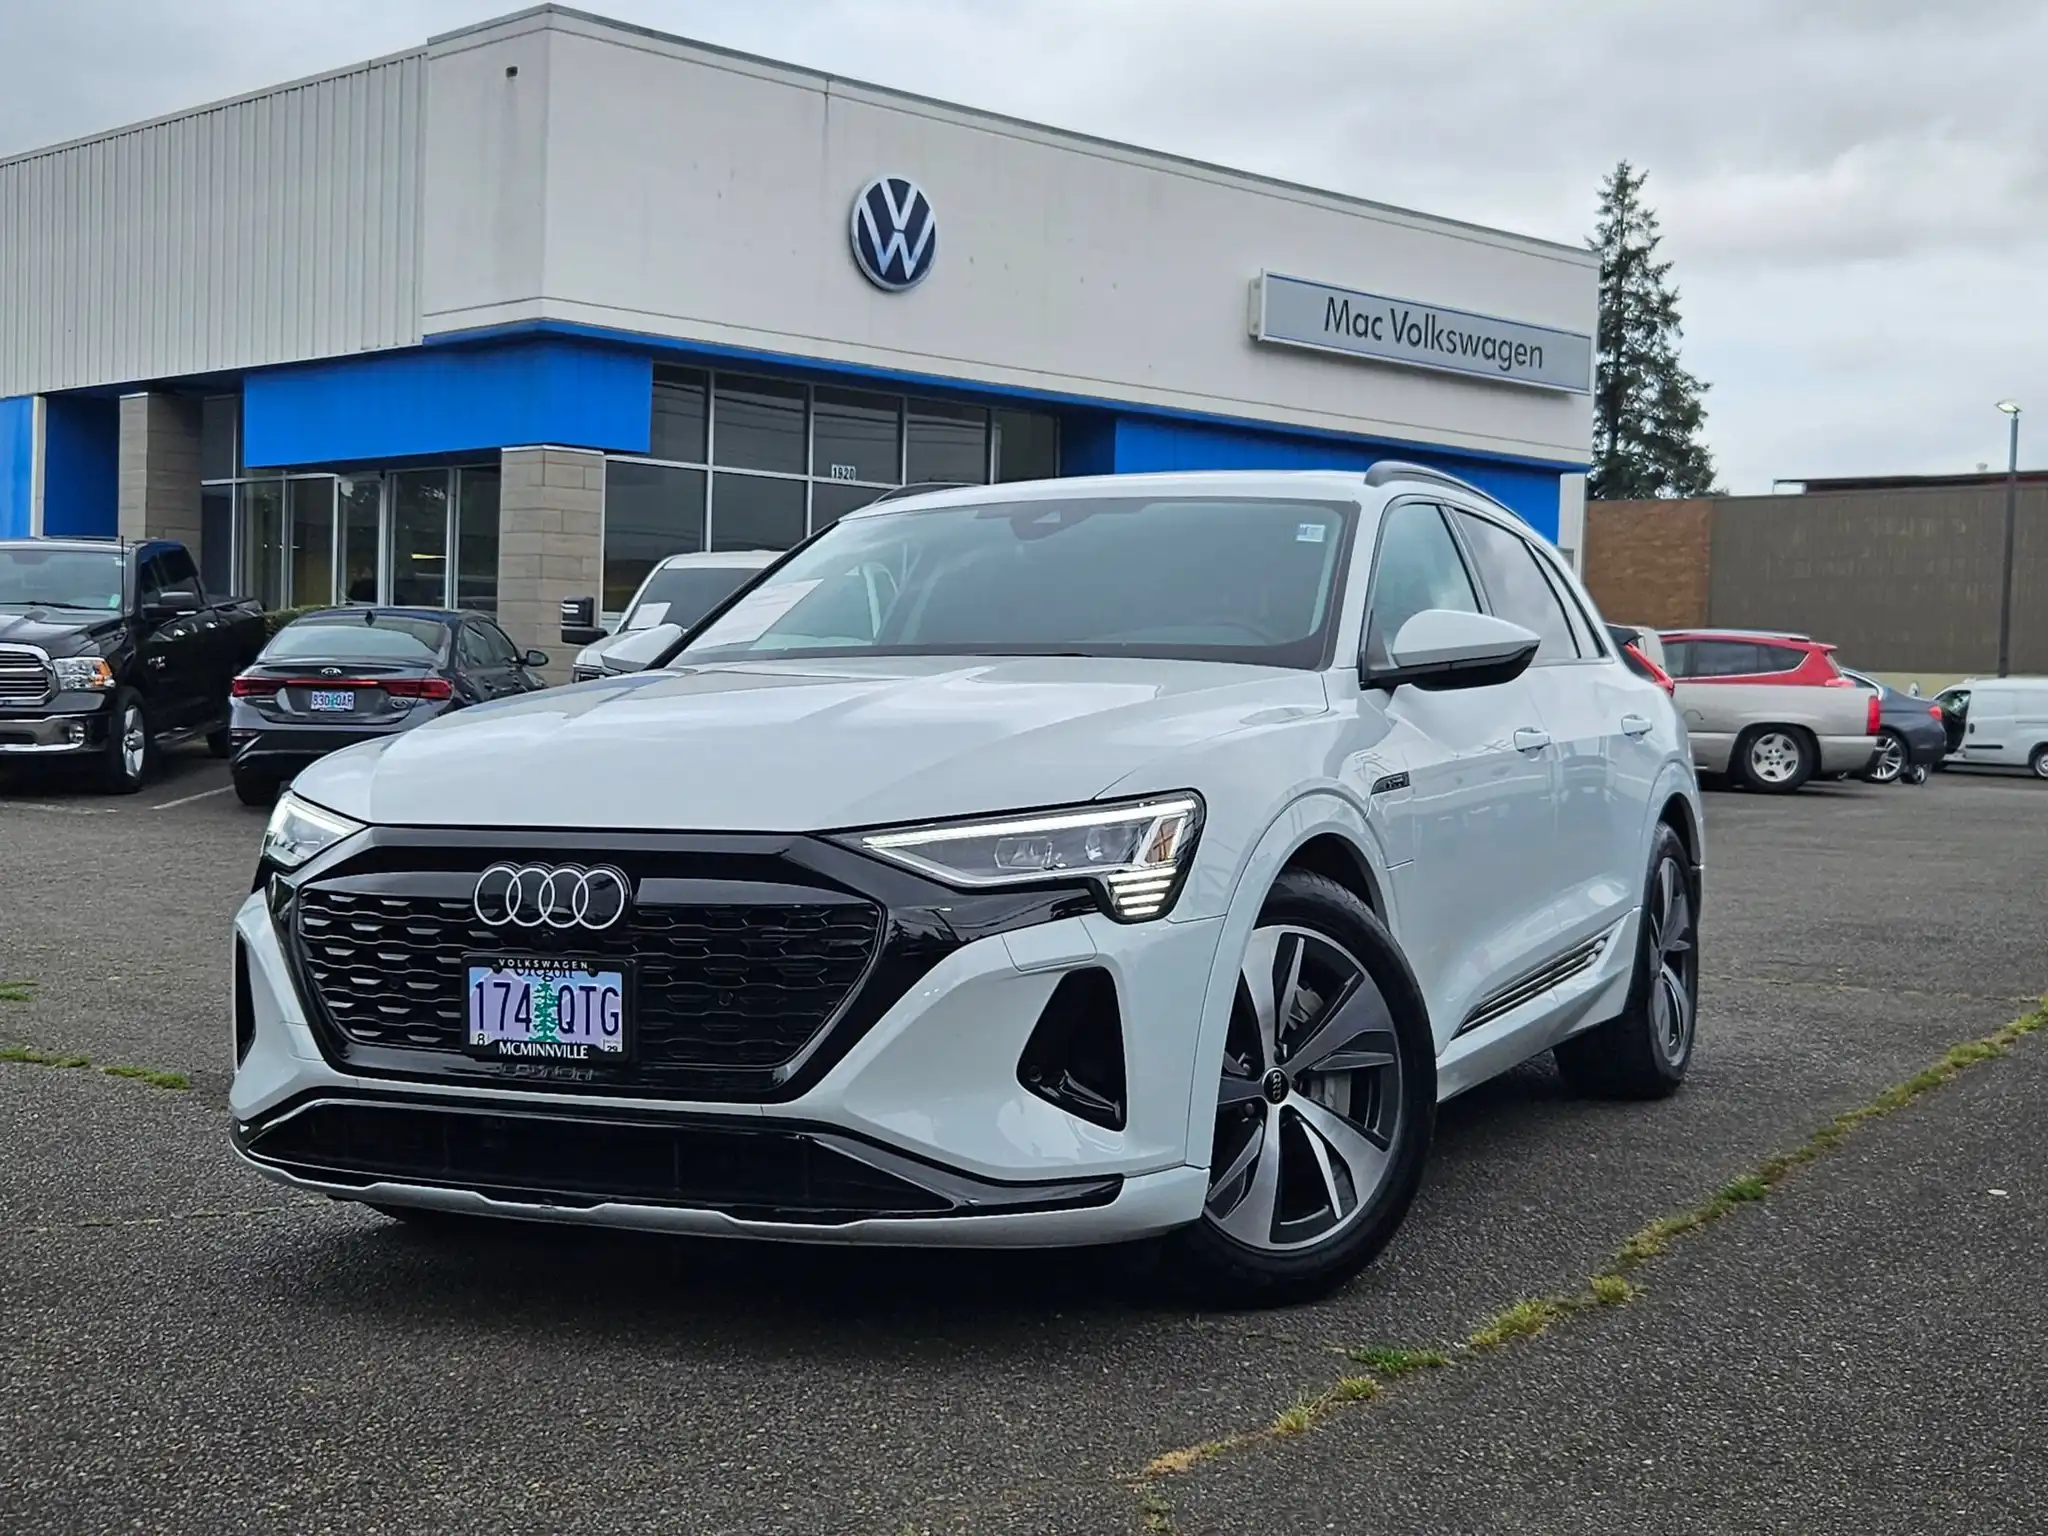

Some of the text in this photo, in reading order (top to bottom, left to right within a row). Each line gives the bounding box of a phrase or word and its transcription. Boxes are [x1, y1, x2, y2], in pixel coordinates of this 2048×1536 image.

[1324, 296, 1543, 371] Mac Volkswagen
[833, 467, 855, 480] 1920
[499, 959, 588, 969] VOLKSWAGEN
[475, 981, 619, 1036] 174 QTG
[499, 1041, 589, 1059] MCMINNVILLE
